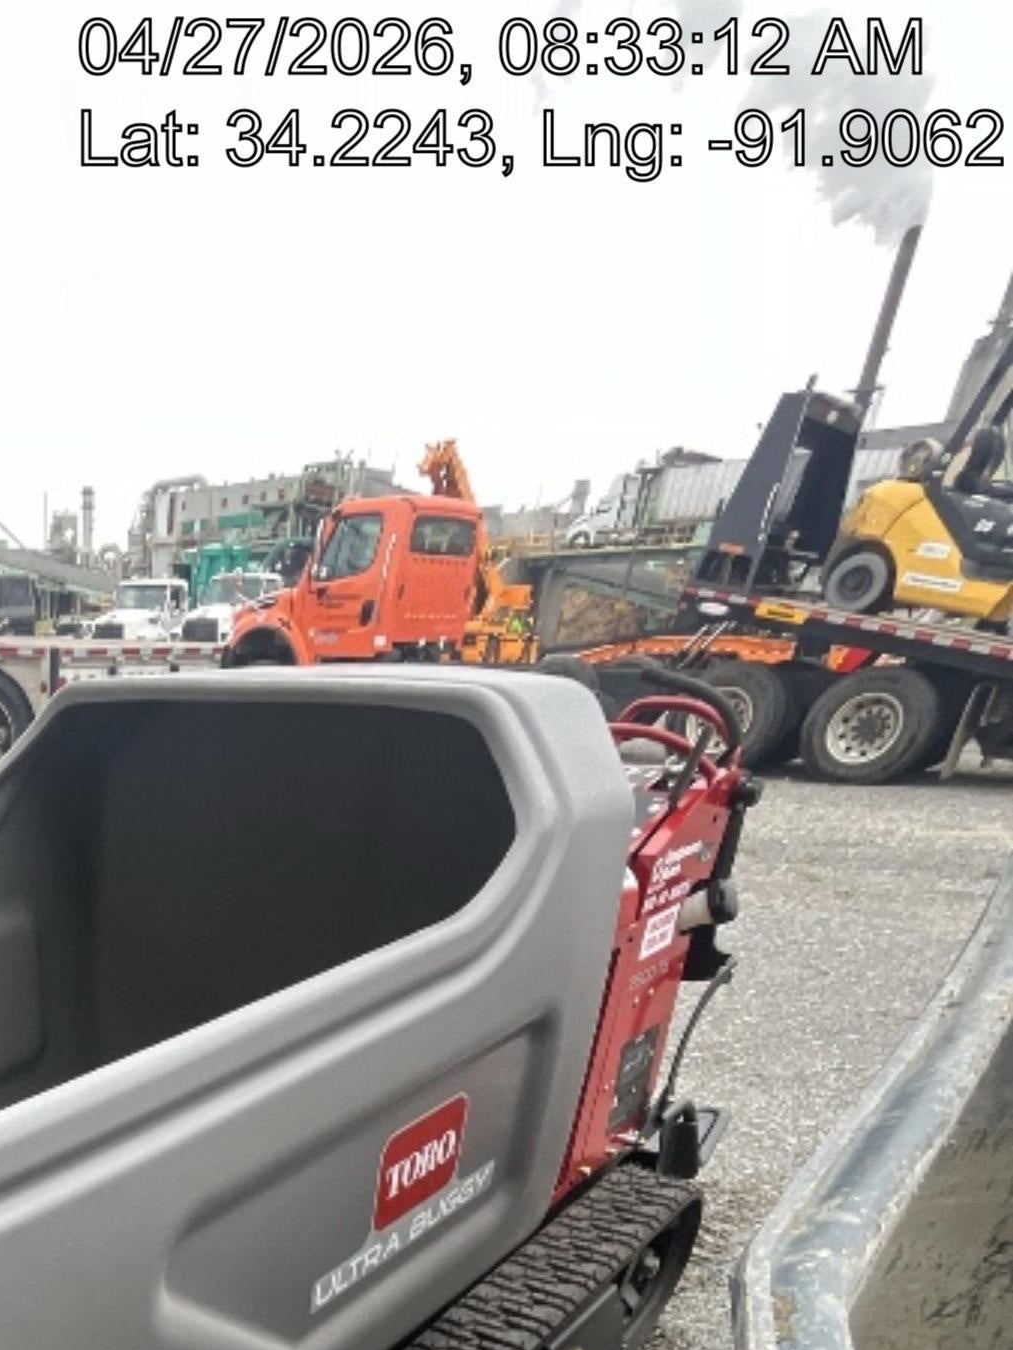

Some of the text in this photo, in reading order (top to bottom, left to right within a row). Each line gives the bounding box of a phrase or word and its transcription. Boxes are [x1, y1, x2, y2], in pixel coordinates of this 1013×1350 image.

[385, 1128, 457, 1200] TORO
[315, 1164, 495, 1308] ULTRA BUGGY
